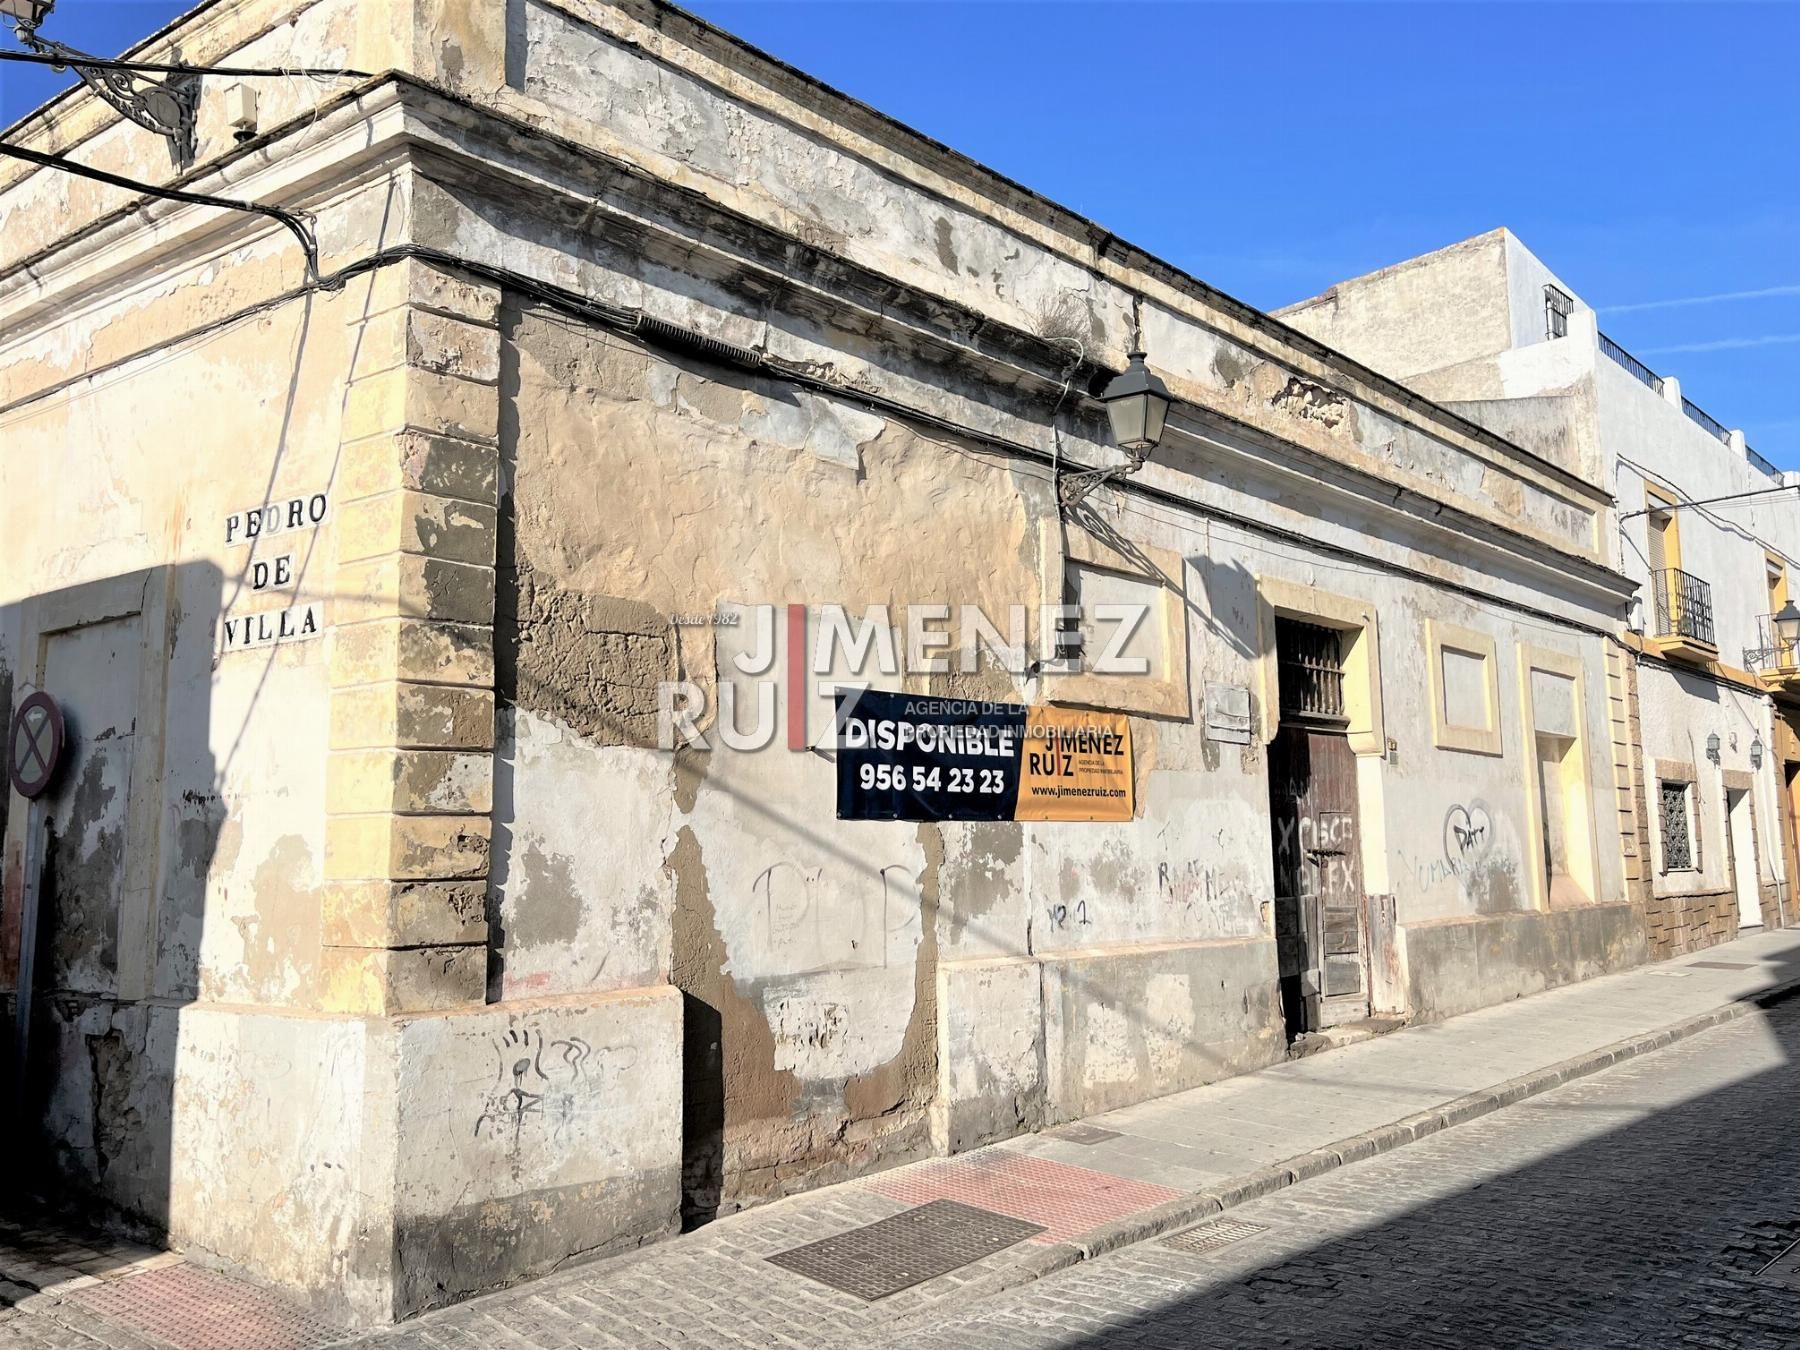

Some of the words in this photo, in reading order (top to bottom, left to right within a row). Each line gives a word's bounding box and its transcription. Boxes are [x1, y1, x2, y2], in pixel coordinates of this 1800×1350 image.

[225, 493, 327, 543] PEDRO
[252, 554, 291, 590] DE
[224, 605, 318, 646] VILLA
[845, 716, 1015, 757] DISPONIBLE
[859, 762, 907, 791] 956
[912, 766, 942, 792] 54
[947, 767, 975, 794] 23
[979, 769, 1005, 794] 23
[1029, 752, 1074, 777] RUIZ
[1031, 785, 1127, 798] www.jimenezruiz.com
